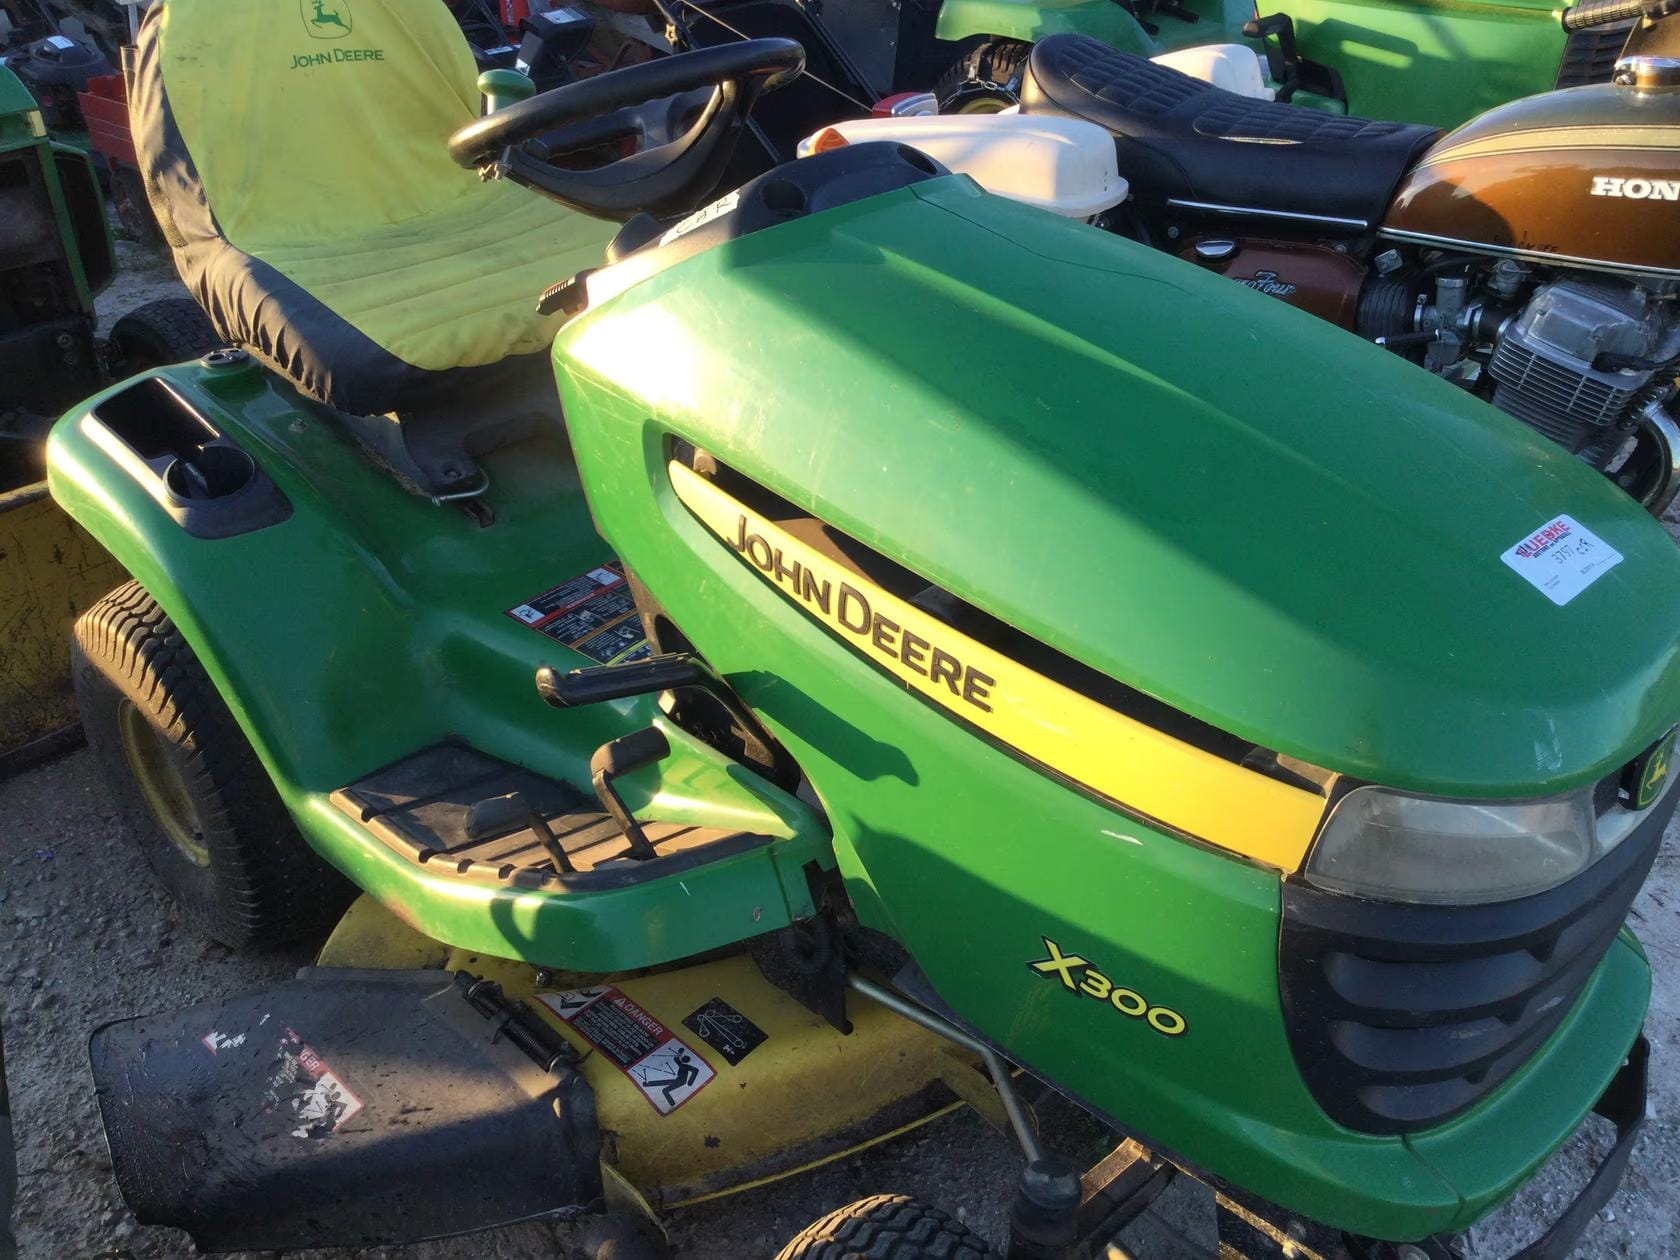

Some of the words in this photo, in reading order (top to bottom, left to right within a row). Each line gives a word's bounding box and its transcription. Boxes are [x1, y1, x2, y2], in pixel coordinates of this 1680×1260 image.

[290, 53, 332, 70] JOHN
[333, 48, 385, 63] DEERE
[1590, 176, 1680, 201] HON
[727, 514, 831, 615] JOHN
[838, 581, 996, 713] DEERE
[1026, 935, 1188, 1037] X300
[624, 1003, 664, 1036] DANGER
